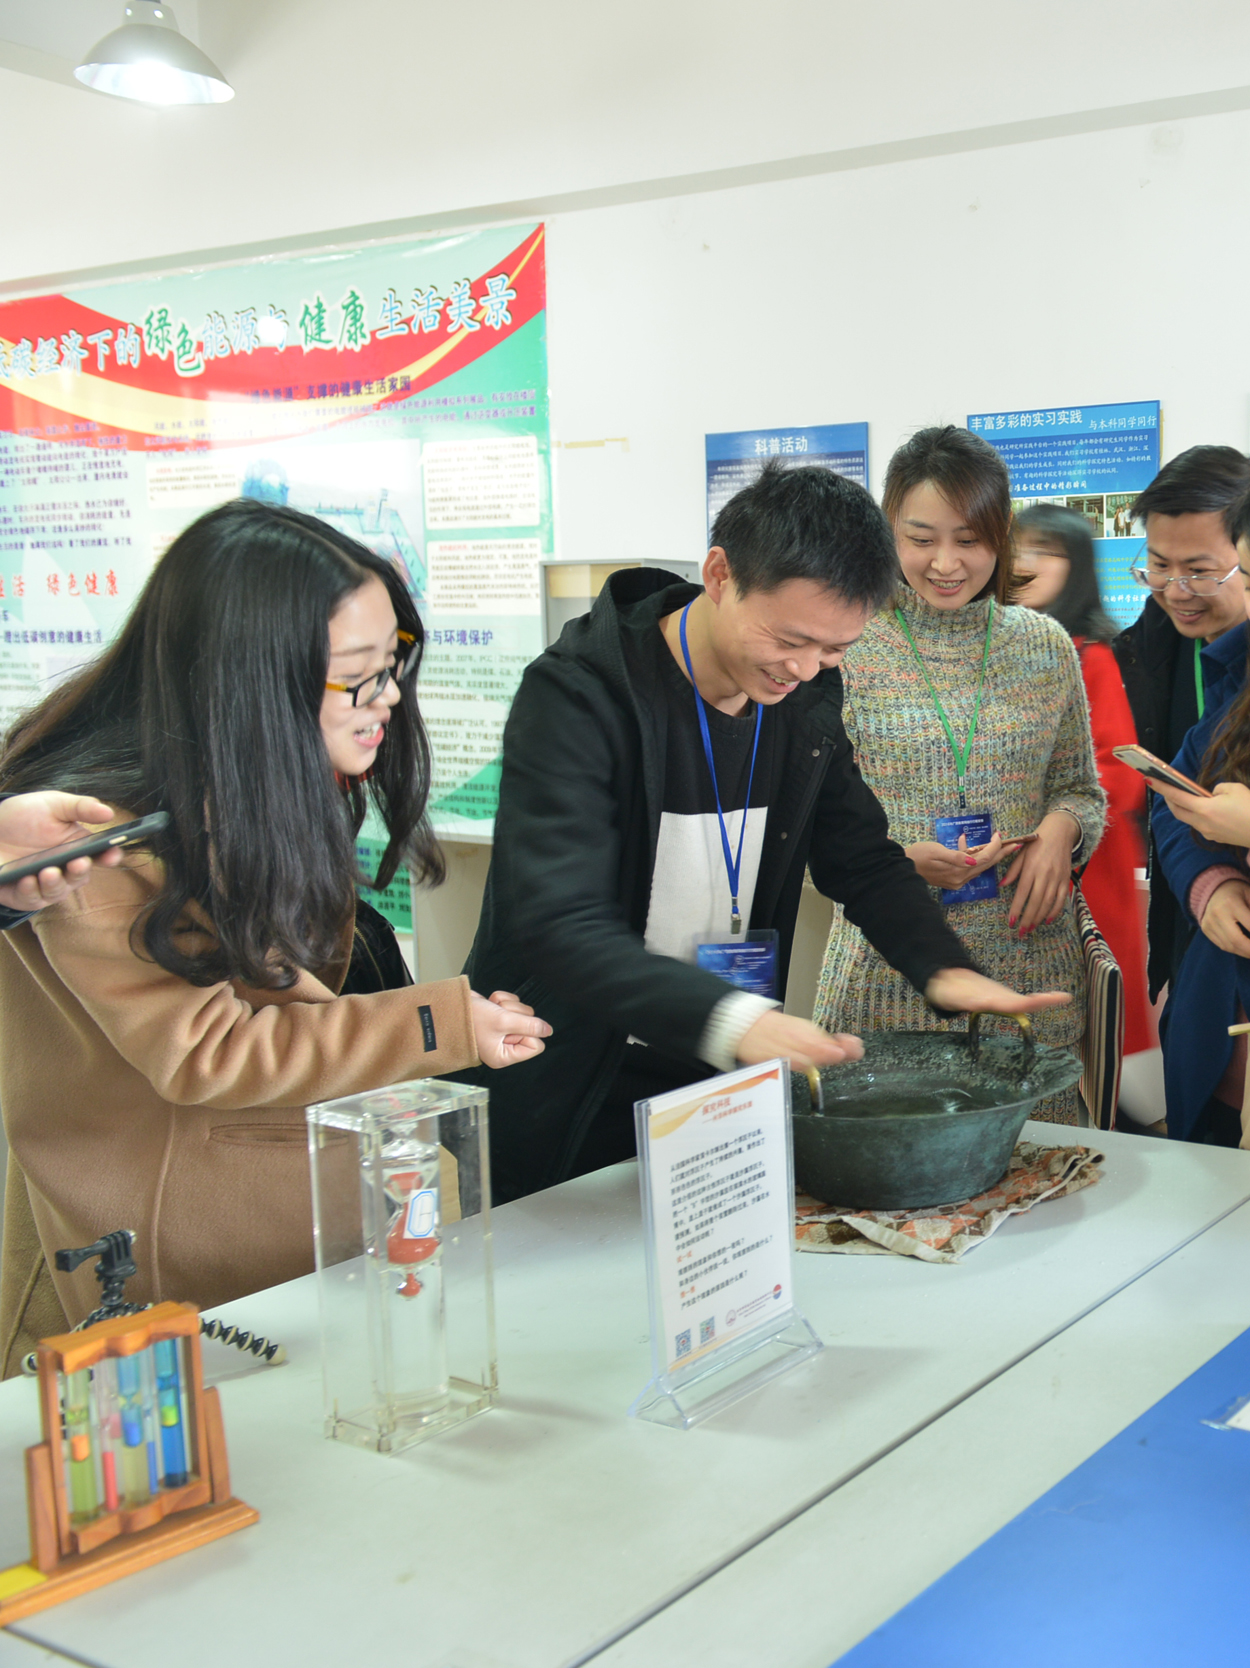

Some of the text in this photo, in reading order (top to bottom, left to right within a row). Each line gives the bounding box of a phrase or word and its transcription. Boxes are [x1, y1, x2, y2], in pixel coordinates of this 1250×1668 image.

[971, 409, 1083, 432] 丰富多彩的实习实践
[1088, 415, 1157, 431] 与本科同学同行
[754, 436, 808, 455] 科普活动
